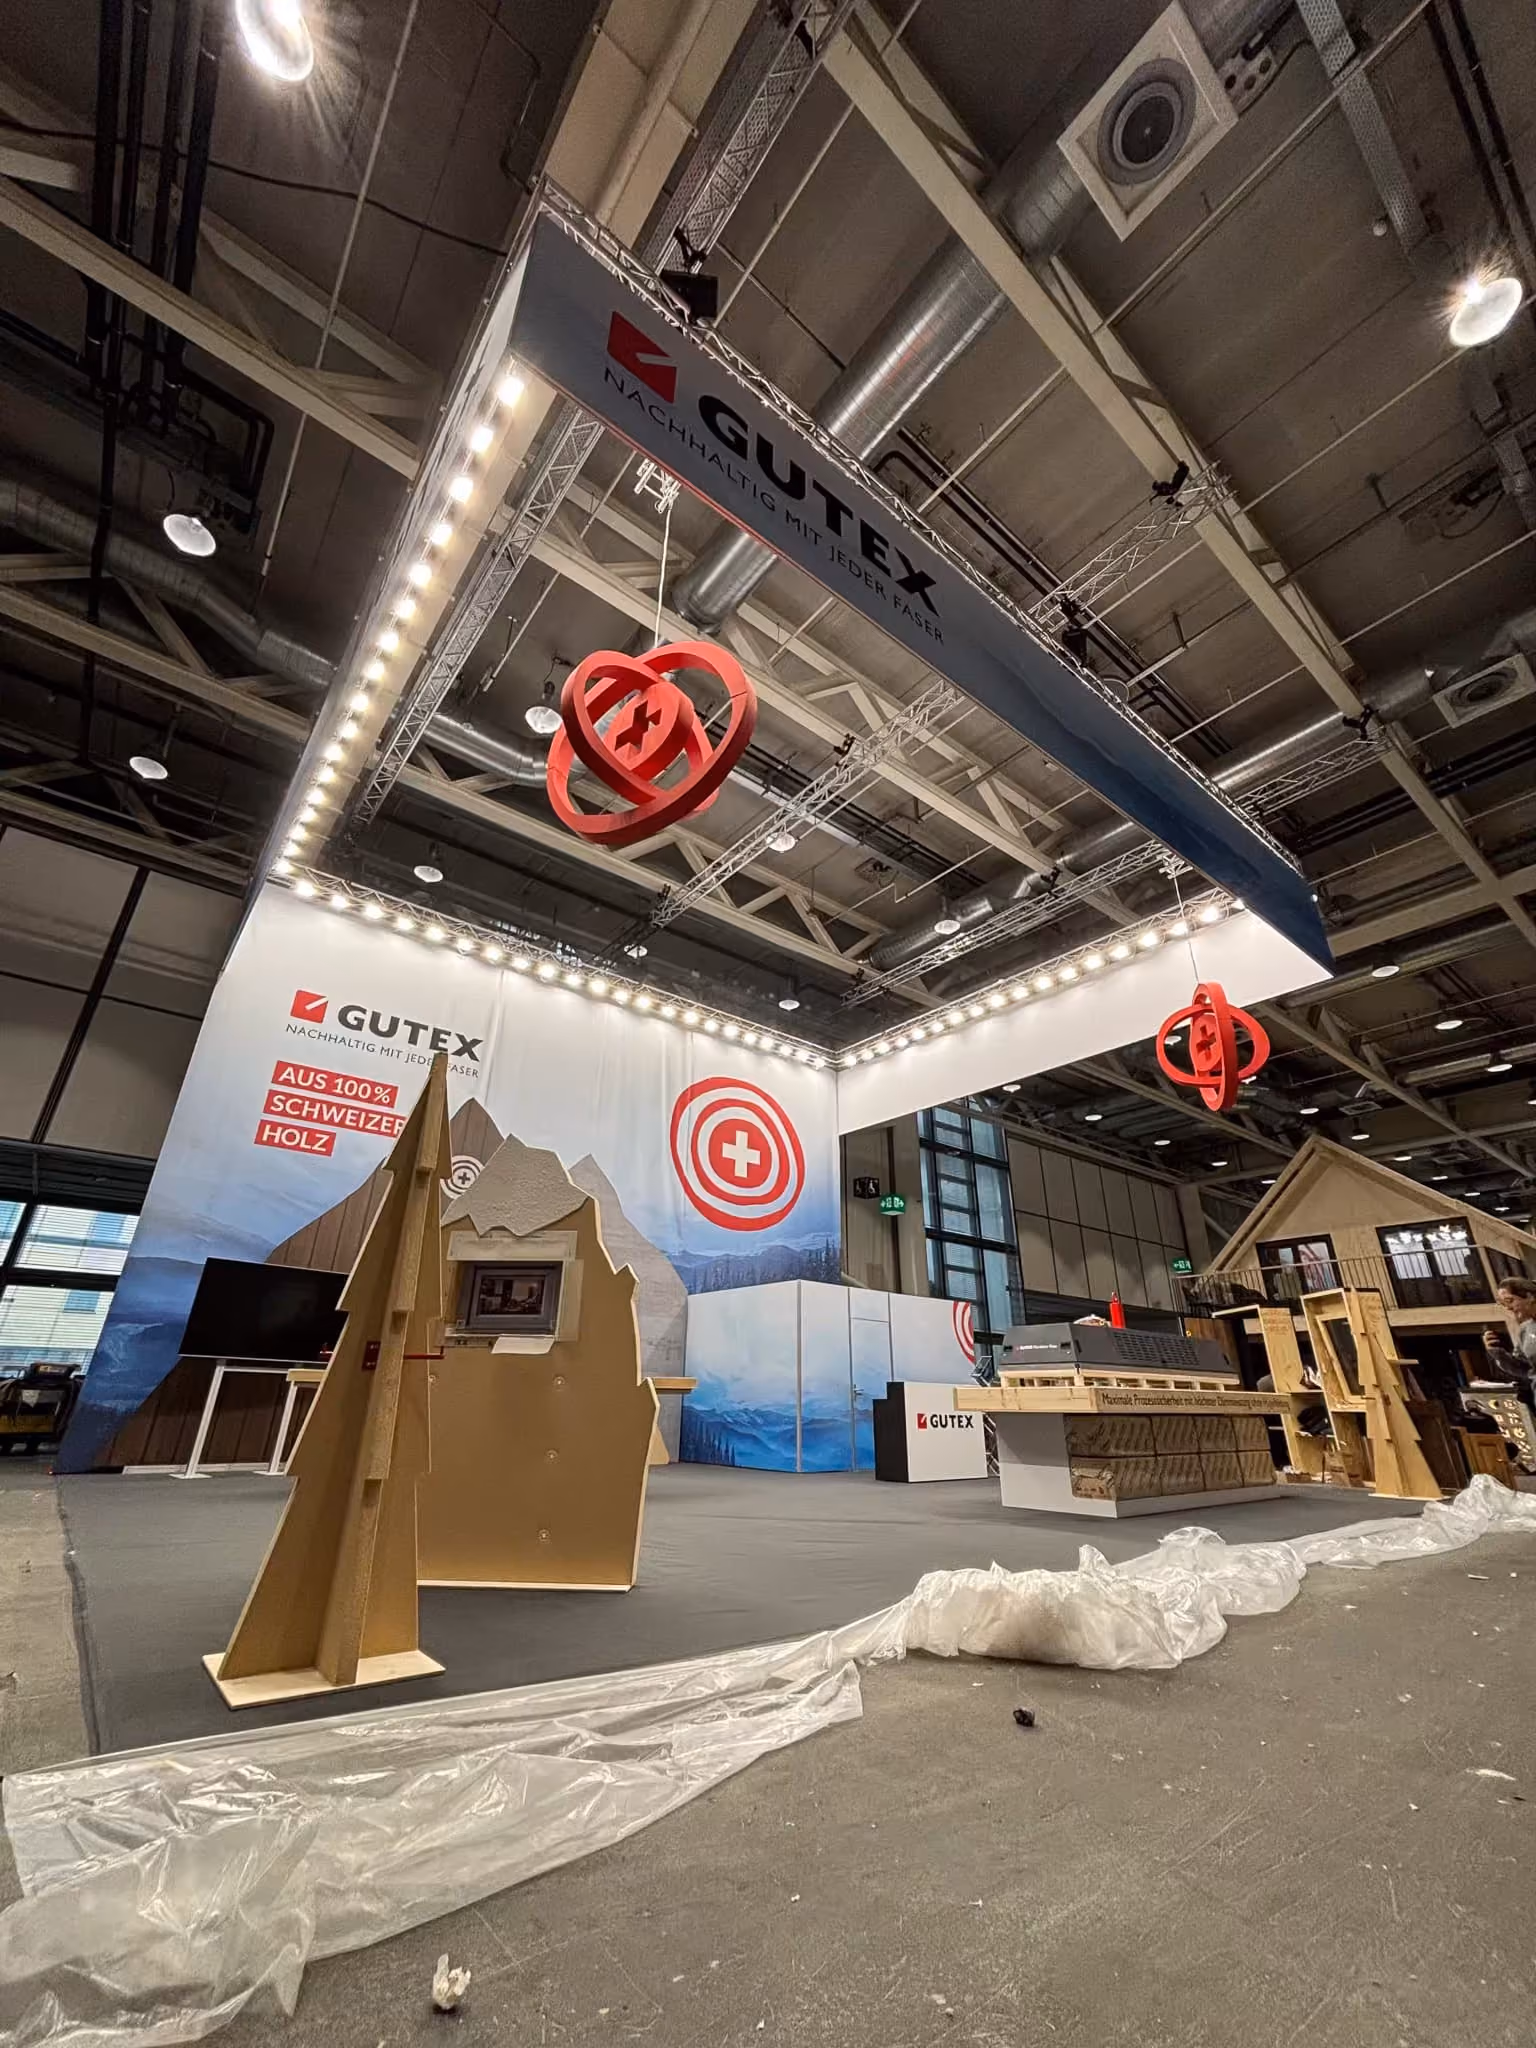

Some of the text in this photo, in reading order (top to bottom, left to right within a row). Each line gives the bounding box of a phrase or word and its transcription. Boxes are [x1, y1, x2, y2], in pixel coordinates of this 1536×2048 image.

[603, 367, 945, 645] NACHHALTIG MIT JEDER FASER
[698, 395, 941, 618] GUTEX
[285, 1023, 376, 1053] NACHHALTIG
[379, 1045, 403, 1059] MIT
[404, 1053, 433, 1067] JEDE
[337, 1004, 484, 1062] GUTEX
[277, 1066, 327, 1090] AUS
[262, 1124, 330, 1152] HOLZ
[930, 1413, 974, 1429] GUTEX
